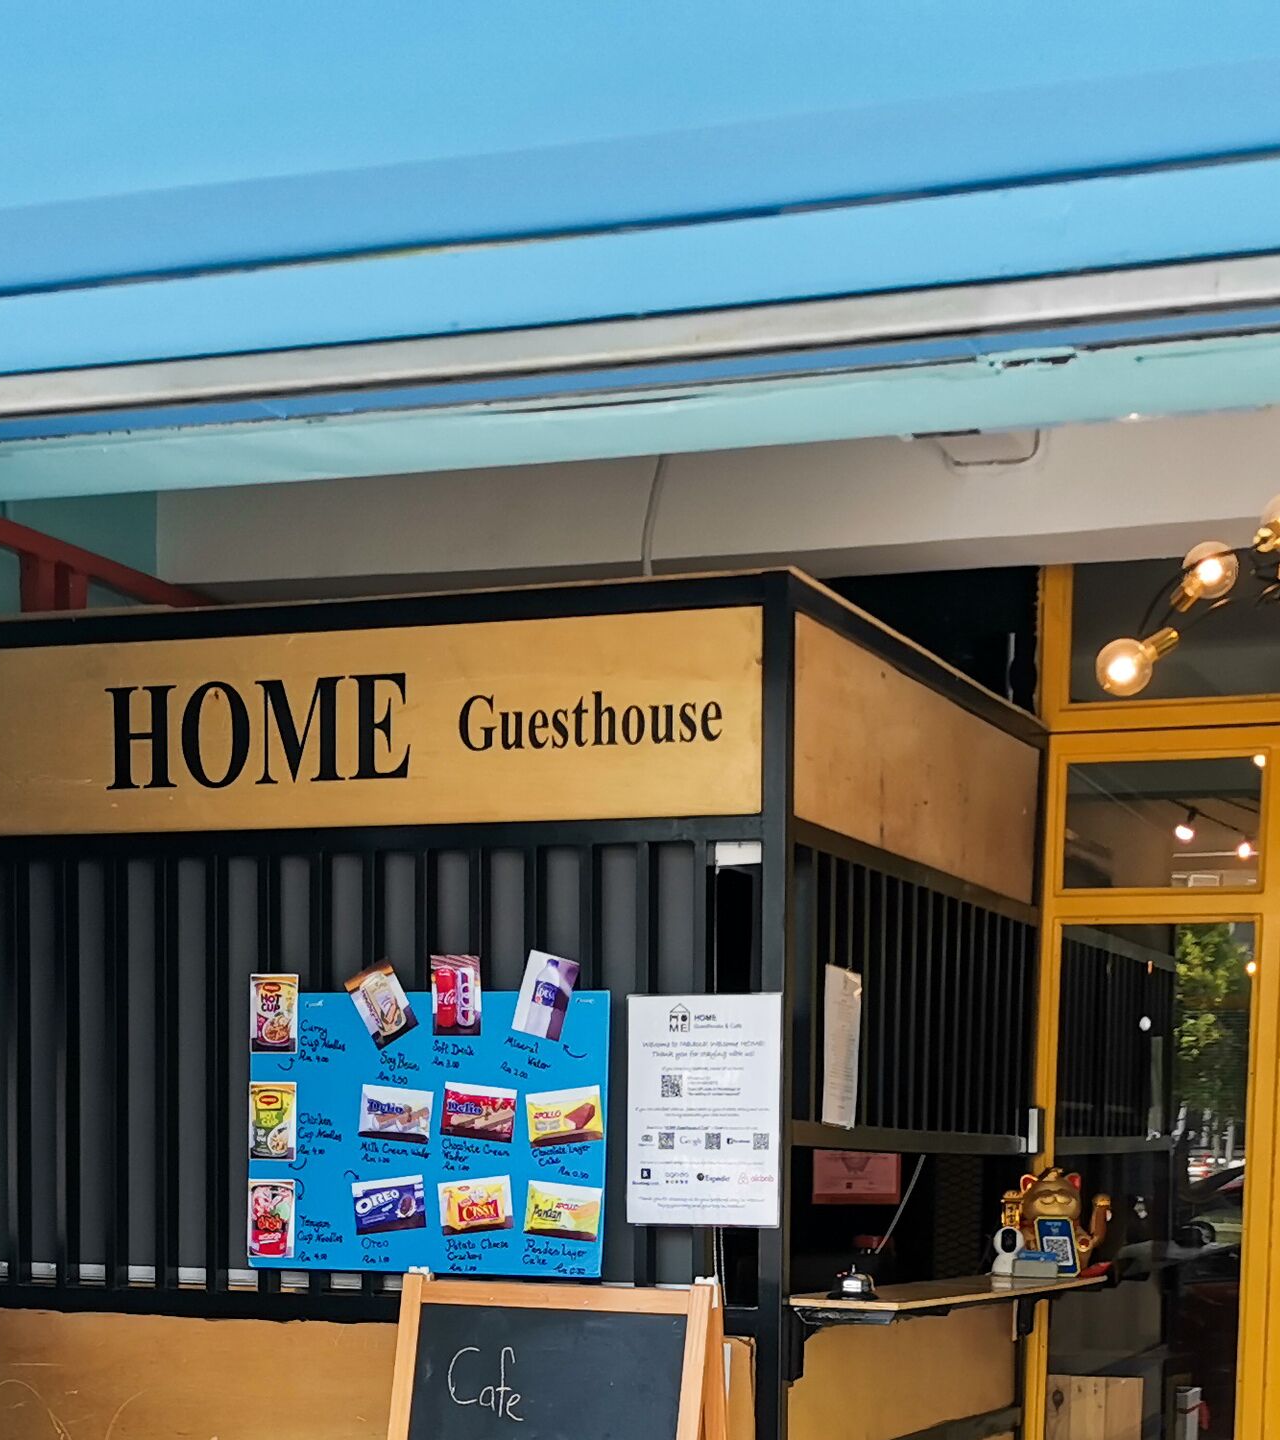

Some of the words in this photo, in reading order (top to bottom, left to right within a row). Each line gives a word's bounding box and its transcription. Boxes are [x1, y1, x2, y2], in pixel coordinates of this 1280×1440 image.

[104, 672, 411, 791] HOME
[459, 691, 723, 752] Guesthouse
[300, 1019, 328, 1039] Curry
[300, 1036, 319, 1052] Cup
[432, 1039, 449, 1055] Soft
[380, 1050, 397, 1071] Soy
[534, 1110, 562, 1119] APOLLO
[355, 1189, 400, 1214] OREO
[361, 1237, 389, 1249] Oreo
[448, 1347, 524, 1421] Cafe
